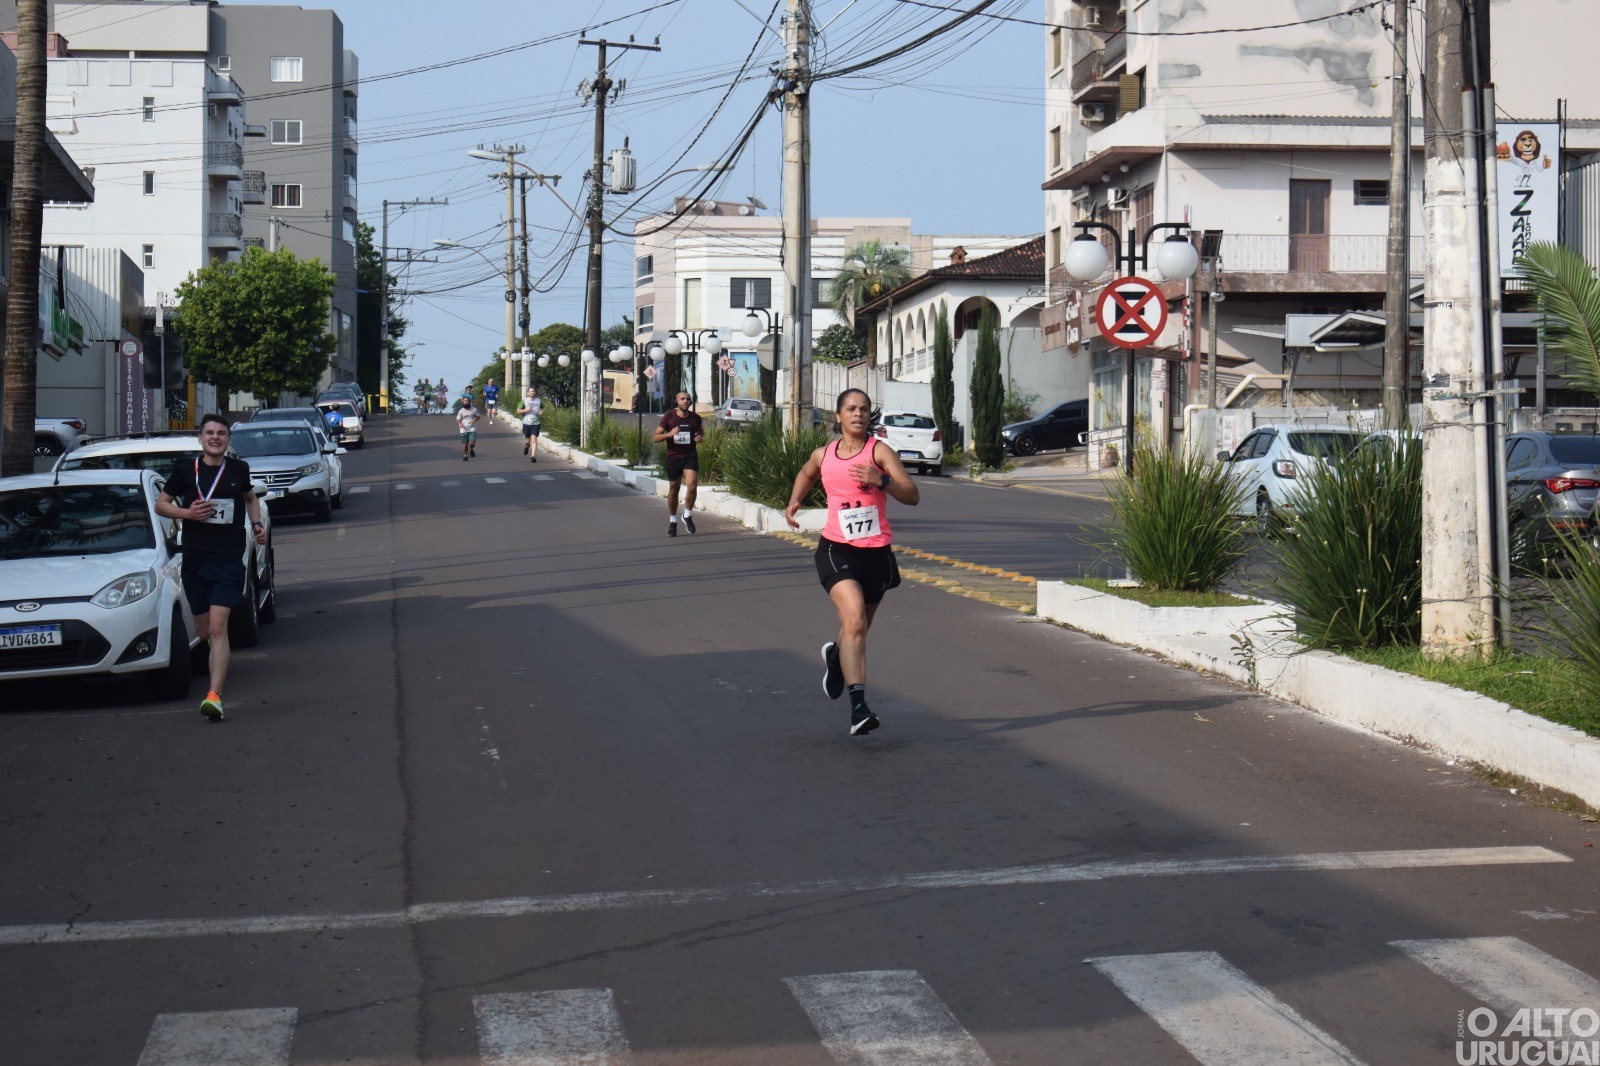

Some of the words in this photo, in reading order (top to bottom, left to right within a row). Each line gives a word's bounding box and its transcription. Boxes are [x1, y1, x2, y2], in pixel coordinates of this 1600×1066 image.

[210, 509, 225, 520] 21
[846, 519, 873, 535] 177
[1, 632, 55, 648] IVD4B61
